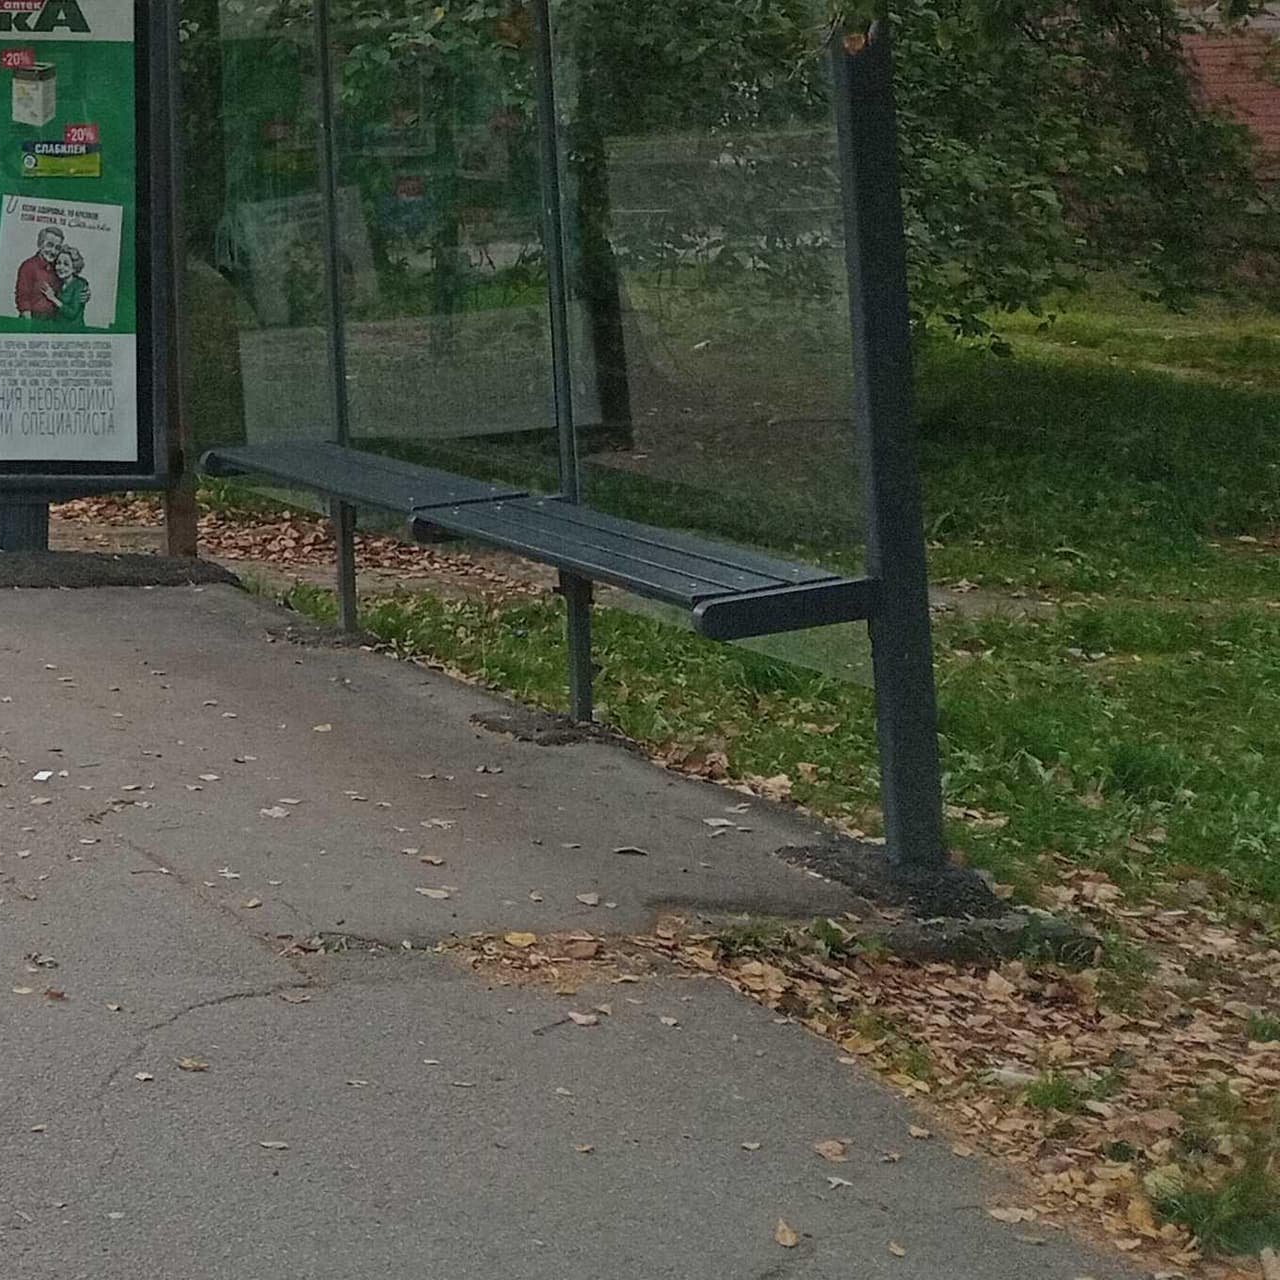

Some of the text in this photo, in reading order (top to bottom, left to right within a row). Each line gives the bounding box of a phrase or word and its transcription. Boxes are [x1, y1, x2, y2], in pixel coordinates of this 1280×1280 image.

[4, 0, 41, 10] аптек
[3, 52, 31, 65] -20%
[67, 127, 95, 141] -20%
[28, 387, 115, 411] НЕОБХОДИМО
[22, 411, 115, 436] СПЕЦИАЛИСТА
